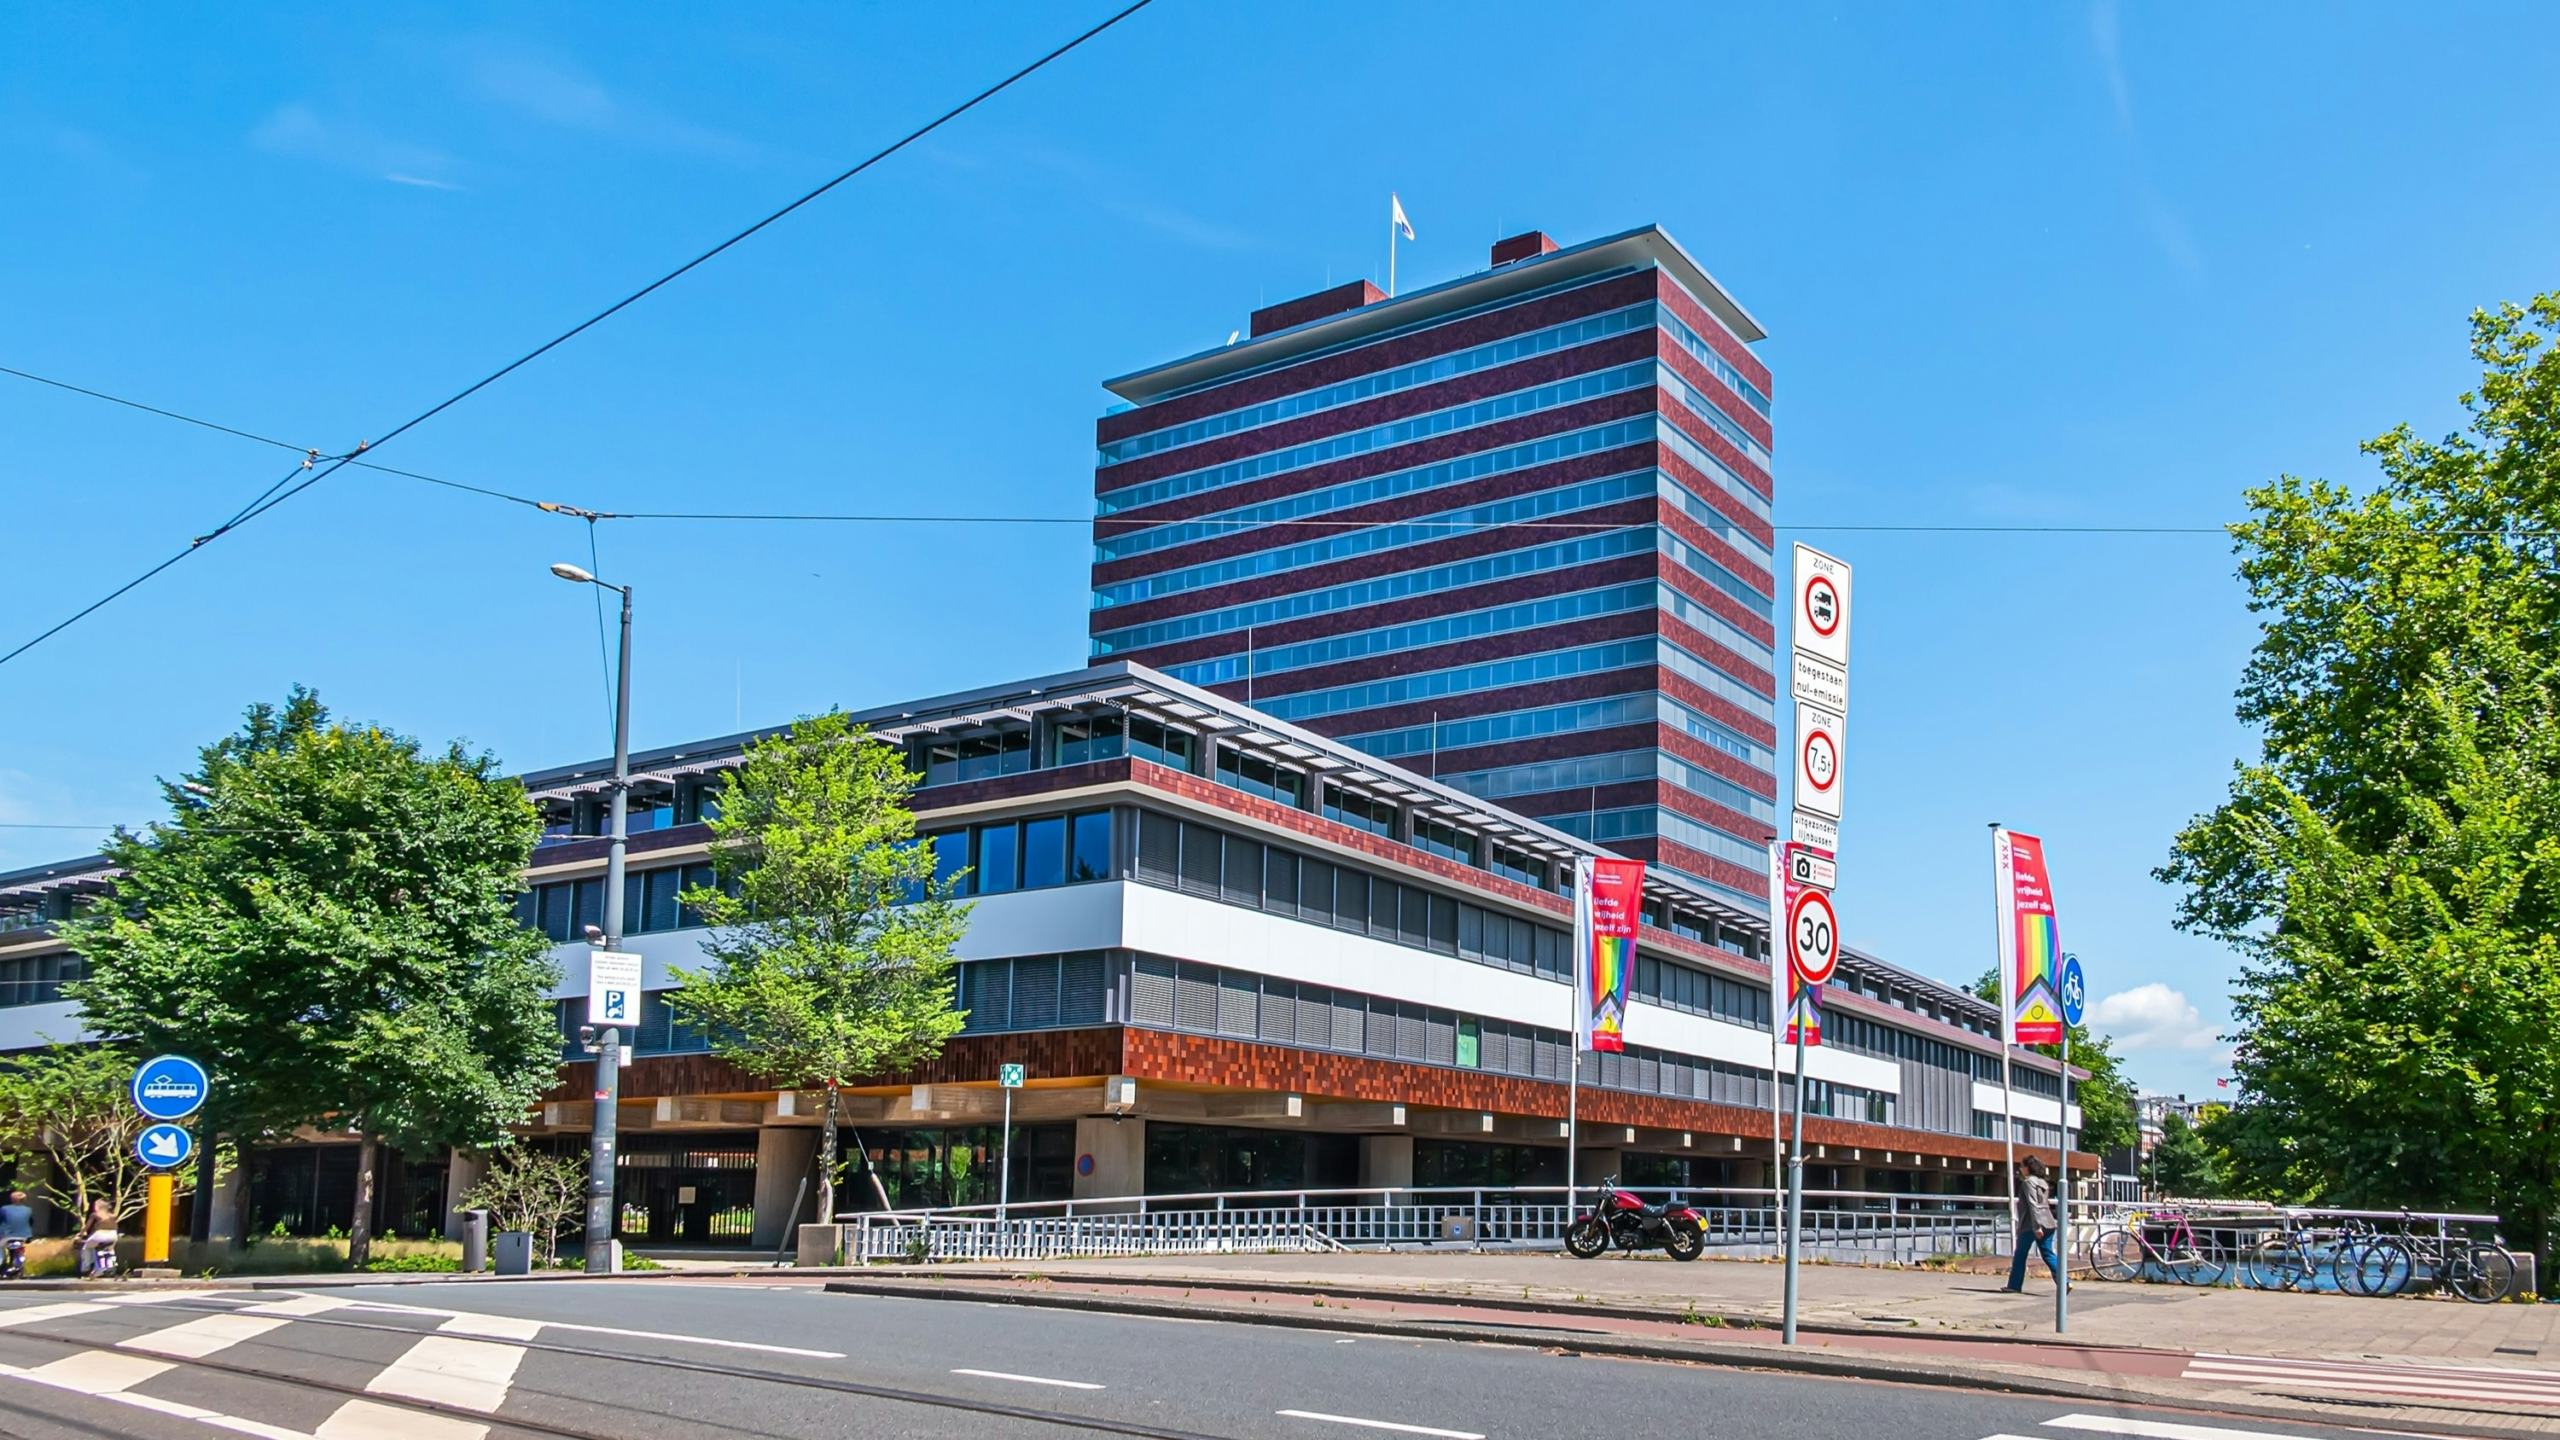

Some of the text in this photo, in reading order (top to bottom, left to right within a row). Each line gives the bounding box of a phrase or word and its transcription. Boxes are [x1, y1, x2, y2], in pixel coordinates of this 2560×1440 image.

[1813, 557, 1835, 575] ZONE
[1798, 661, 1843, 687] toegestaan
[1796, 682, 1843, 706] nul-emissie
[1811, 712, 1832, 728] ZONE
[1794, 816, 1837, 835] uitgezonderd
[1798, 828, 1833, 847] lijnbussen
[1799, 916, 1830, 957] 30
